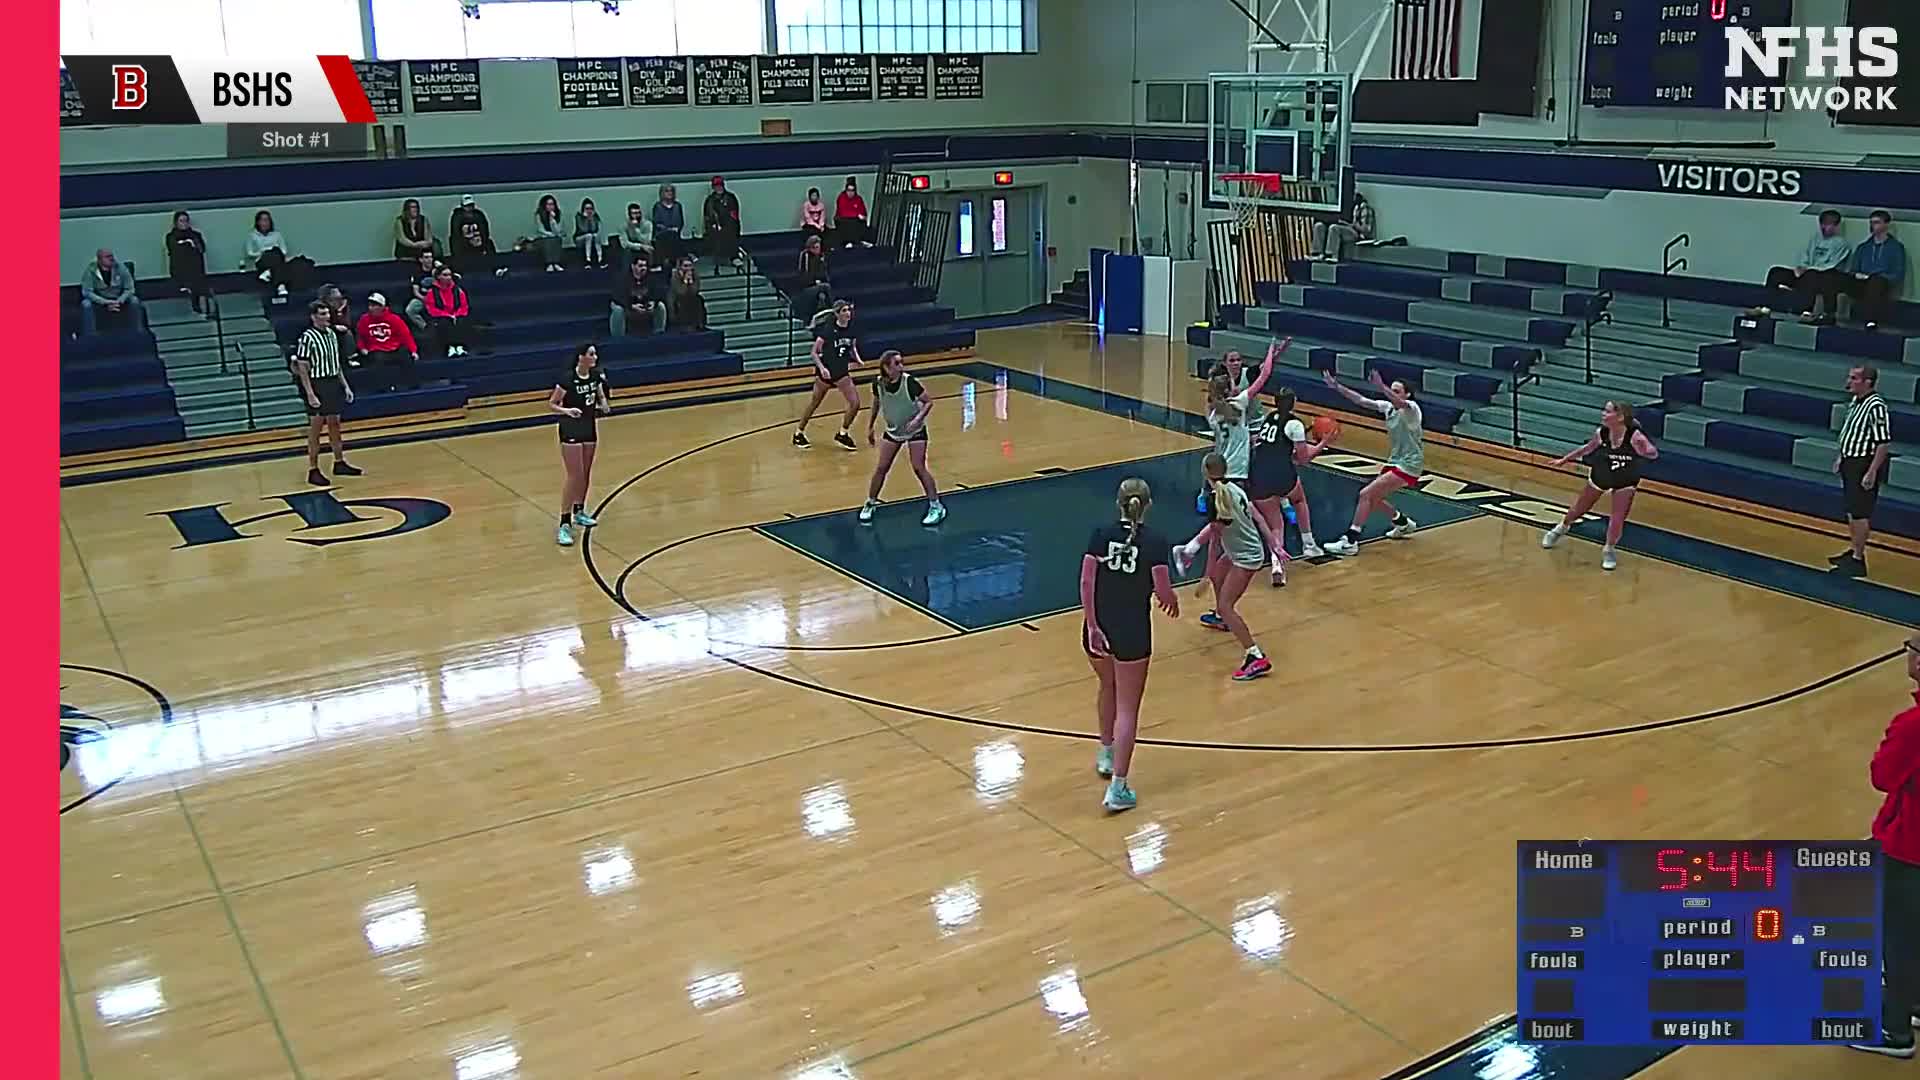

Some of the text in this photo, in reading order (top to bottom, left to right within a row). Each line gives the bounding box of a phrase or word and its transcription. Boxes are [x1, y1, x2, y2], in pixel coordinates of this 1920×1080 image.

[1661, 2, 1698, 19] period
[1659, 29, 1696, 45] player
[562, 71, 618, 81] CHAMPIONS
[761, 69, 810, 78] CHAMPIONS
[821, 67, 870, 76] CHAMPIONS
[879, 67, 925, 75] CHAMPIONS
[937, 67, 980, 75] CHAMPIONS
[414, 73, 476, 83] CHAMPIONS
[645, 78, 671, 87] GOLF
[563, 82, 619, 92] FOOTBALL
[632, 86, 685, 95] CHAMPIONS
[698, 87, 749, 95] CHAMPIONS
[1656, 86, 1692, 100] weight
[1657, 163, 1801, 196] VISITORS
[1260, 422, 1278, 443] 20
[1108, 541, 1138, 573] 53
